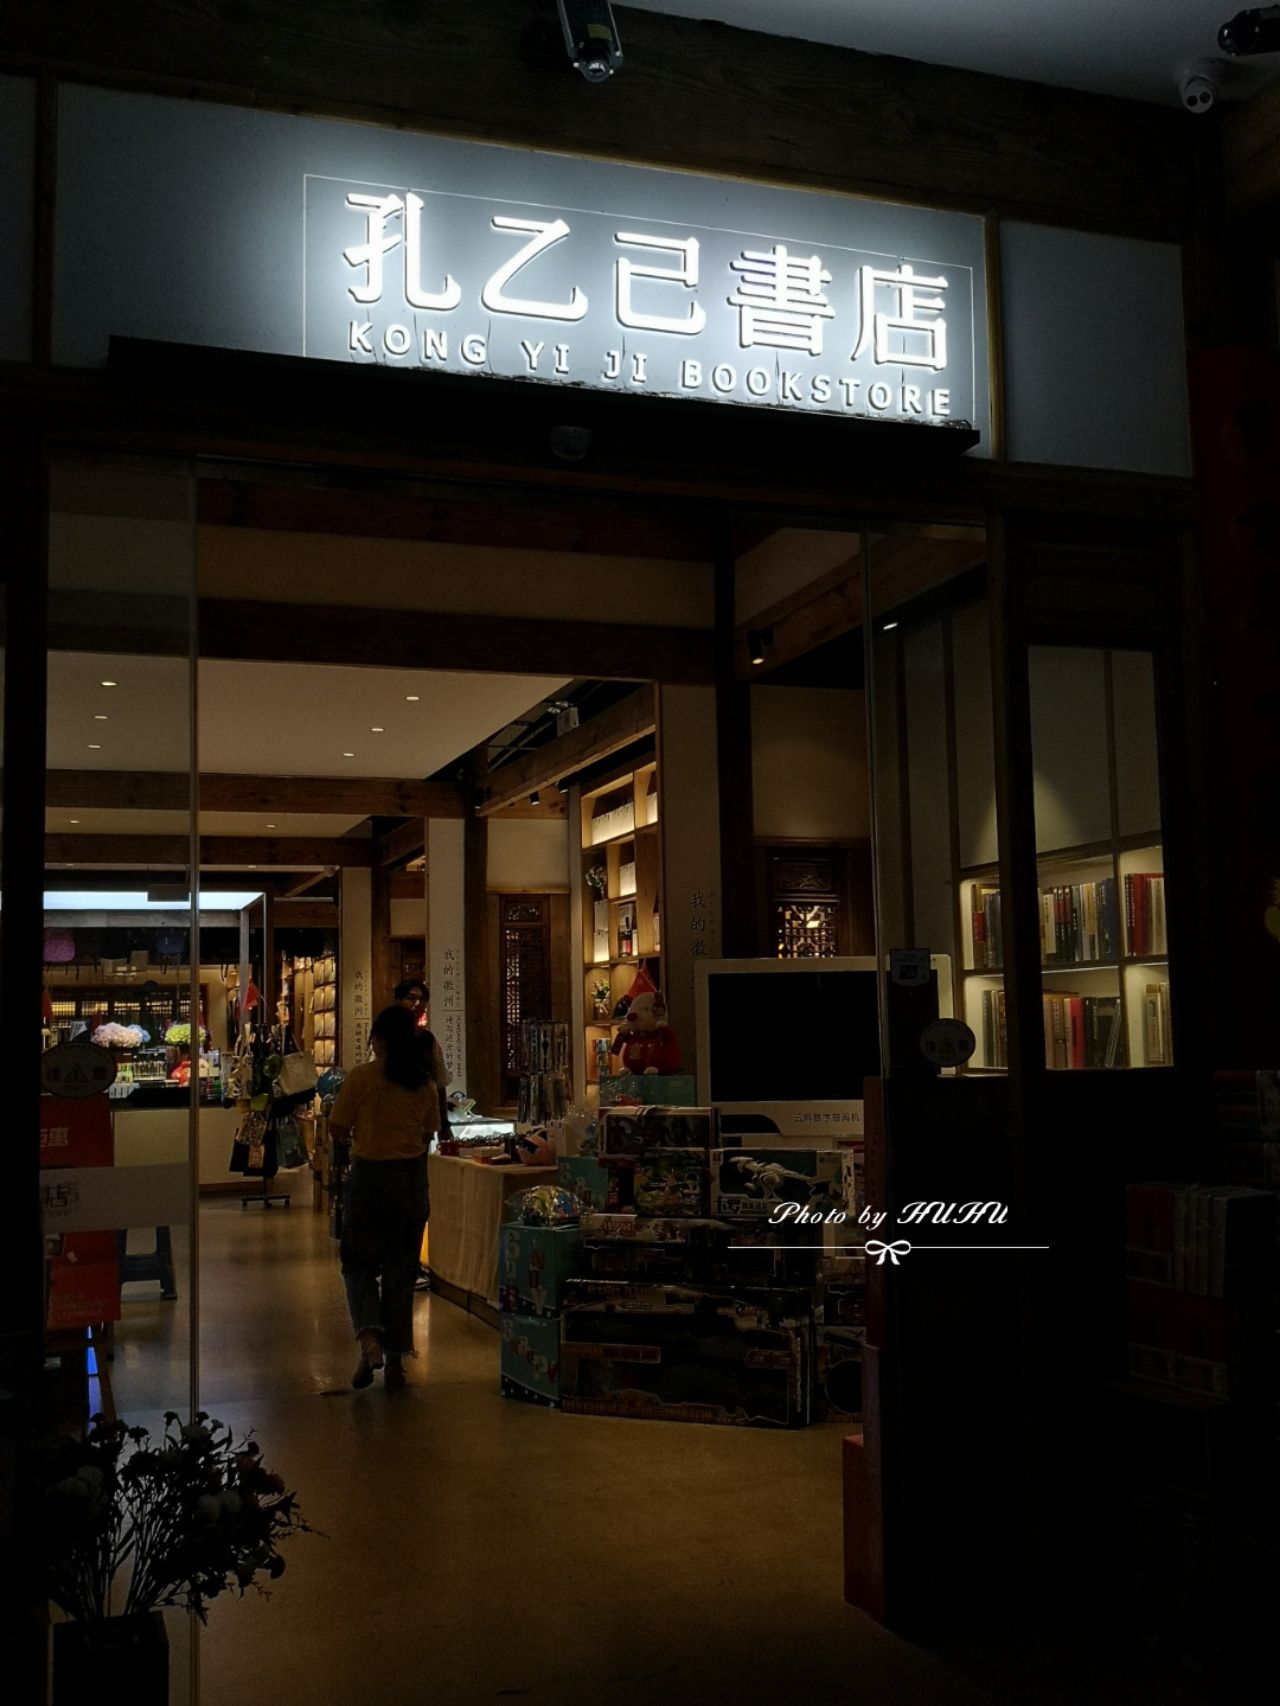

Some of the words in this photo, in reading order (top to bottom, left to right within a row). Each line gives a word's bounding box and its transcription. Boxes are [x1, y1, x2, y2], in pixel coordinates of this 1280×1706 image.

[344, 191, 949, 372] 孔乙己書店
[349, 320, 488, 366] KONG
[521, 340, 571, 375] YI
[605, 350, 648, 385] JI
[681, 359, 951, 417] BOOKSTORE
[689, 890, 706, 989] 我的徽
